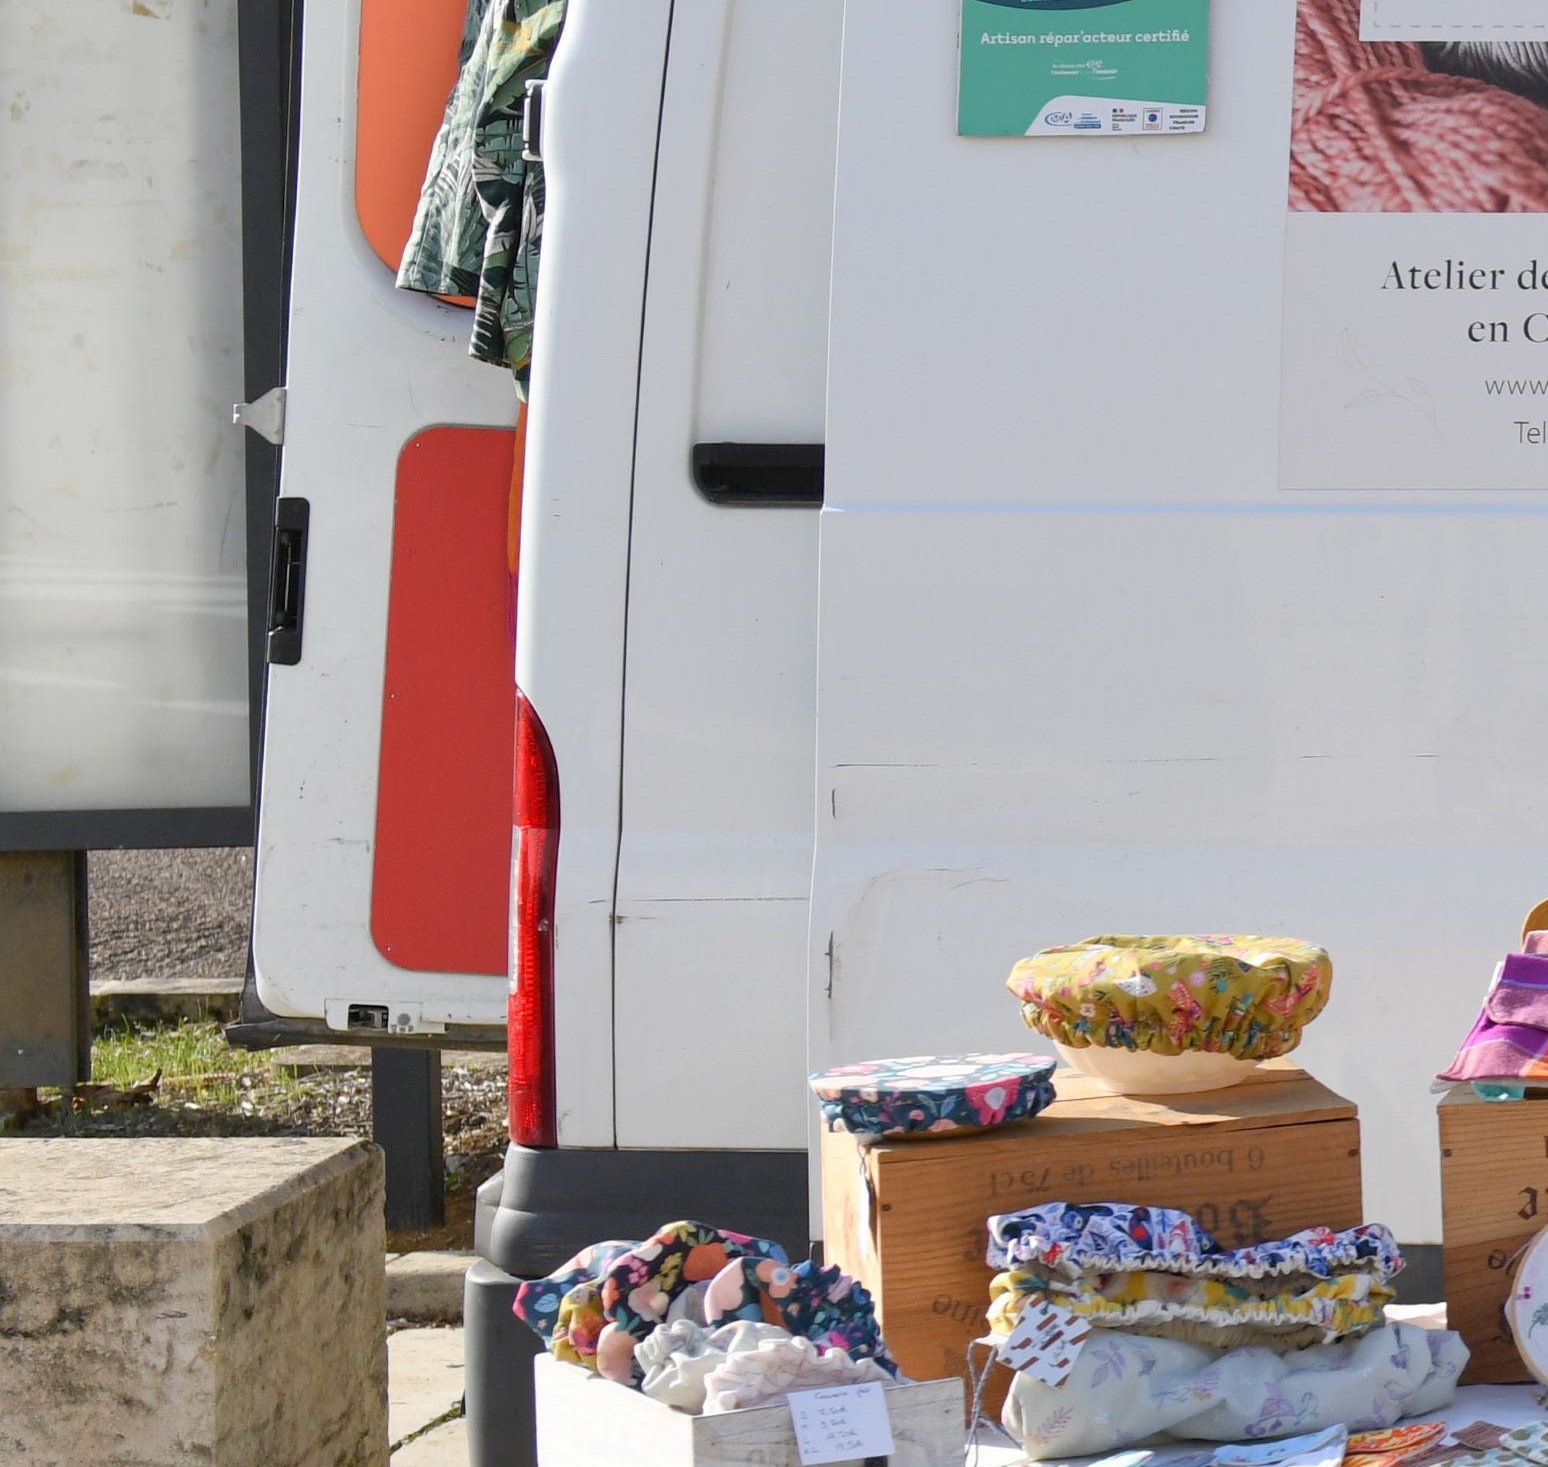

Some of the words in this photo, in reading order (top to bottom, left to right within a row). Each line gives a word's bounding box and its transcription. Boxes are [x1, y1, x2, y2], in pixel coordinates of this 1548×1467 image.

[980, 32, 1036, 44] Artisan
[1135, 29, 1190, 43] certifié
[1380, 260, 1505, 291] Atelier
[1467, 320, 1510, 343] en
[1109, 1149, 1234, 1183] bouteilles
[1246, 1148, 1265, 1174] 6
[1062, 1164, 1095, 1193] de
